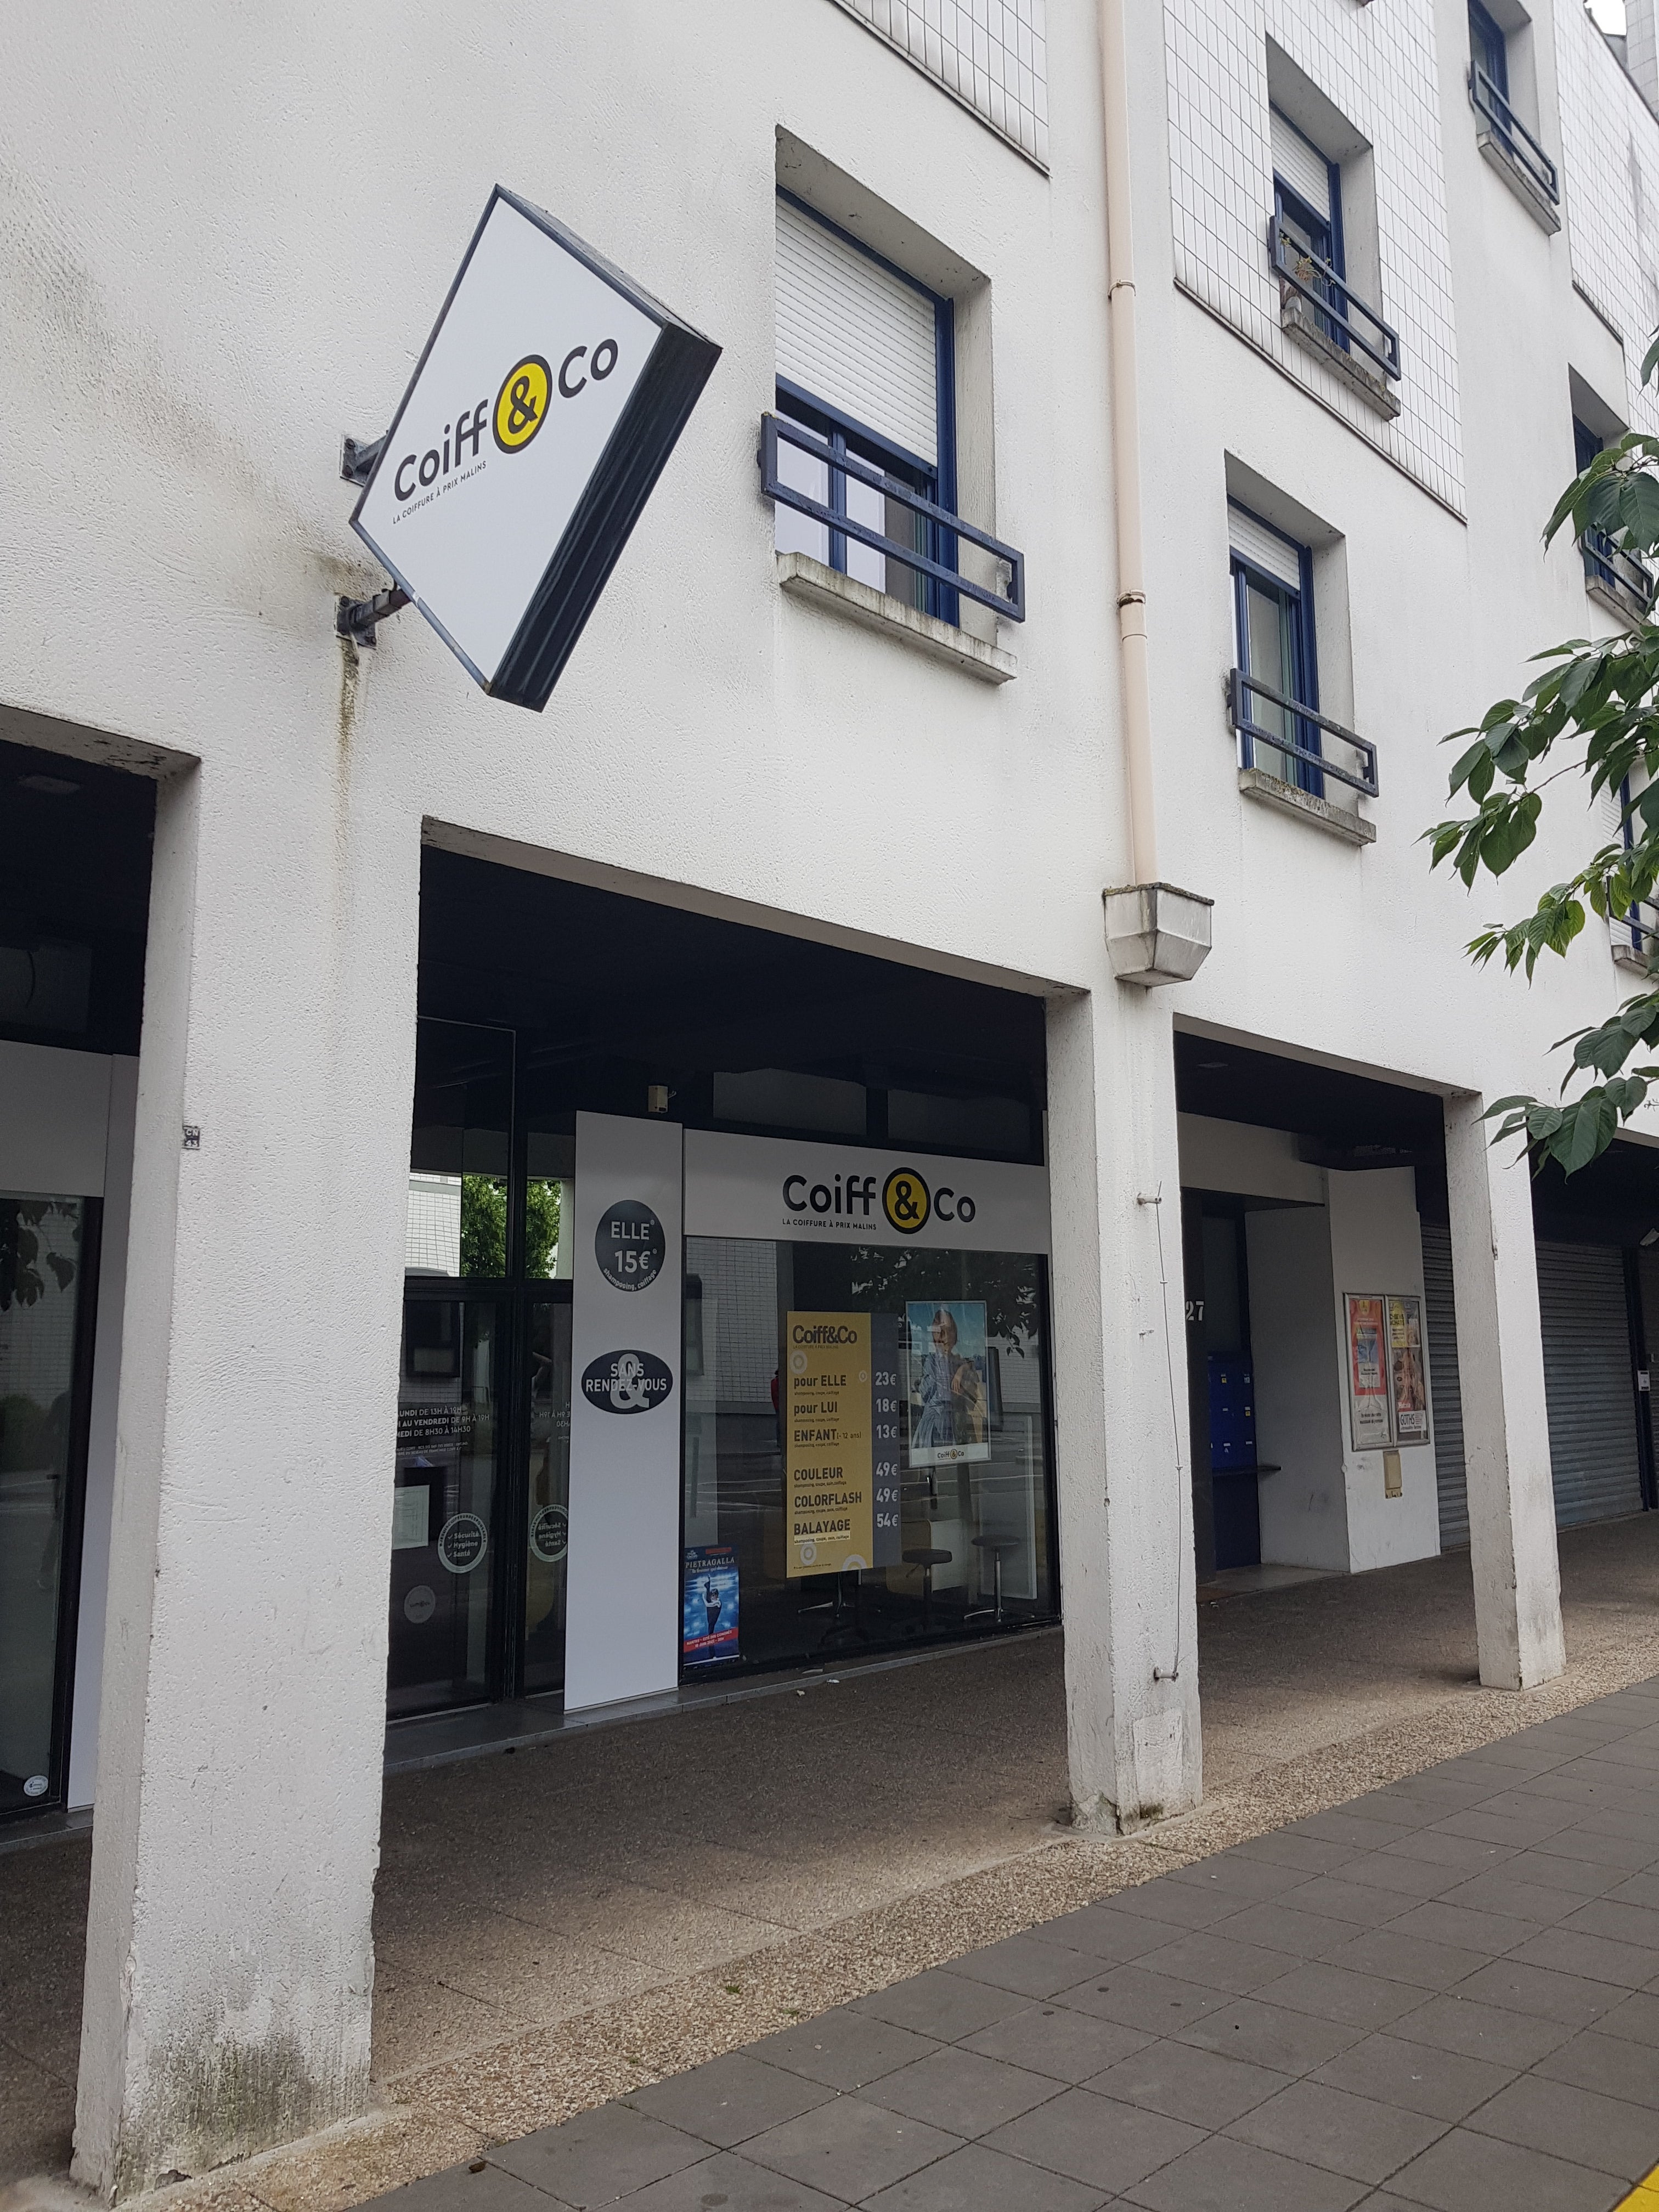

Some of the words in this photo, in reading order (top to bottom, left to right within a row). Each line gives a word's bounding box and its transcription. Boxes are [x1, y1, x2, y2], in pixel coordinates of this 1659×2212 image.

[392, 515, 400, 525] LA
[402, 493, 435, 518] COIFFURE
[436, 487, 441, 498] À
[443, 477, 458, 493] PRIX
[460, 461, 486, 482] MALINS
[611, 1221, 650, 1240] ELLE
[793, 1219, 826, 1227] COIFFURE
[614, 1250, 651, 1273] 15€
[603, 1268, 636, 1291] shampooing,
[637, 1269, 657, 1289] coiffage
[1186, 1301, 1204, 1321] 27
[793, 1325, 857, 1344] Coiff&Co
[610, 1363, 644, 1377] SANS
[586, 1378, 667, 1392] RENDEZ-VOUS
[794, 1377, 818, 1389] pour
[821, 1375, 847, 1386] ELLE
[875, 1372, 896, 1386] 23€
[444, 1406, 449, 1414] À
[794, 1404, 818, 1417] pour
[821, 1401, 837, 1413] LUI
[876, 1398, 897, 1413] 18€
[414, 1418, 449, 1426] VENDREDI
[472, 1414, 477, 1422] À
[1400, 1413, 1415, 1425] GOTHS
[425, 1427, 443, 1436] 8H30
[444, 1425, 449, 1434] À
[794, 1429, 837, 1442] ENFANT
[876, 1425, 898, 1438] 13€
[794, 1467, 843, 1481] COULEUR
[876, 1462, 898, 1476] 49€
[794, 1491, 862, 1508] COLORFLASH
[876, 1488, 898, 1503] 49€
[794, 1519, 850, 1536] BALAYAGE
[877, 1513, 898, 1528] 54€
[454, 1531, 479, 1539] Sécurité
[453, 1541, 478, 1549] Hygiène
[453, 1549, 471, 1558] Santé
[685, 1556, 735, 1568] PIETRAGALLA
